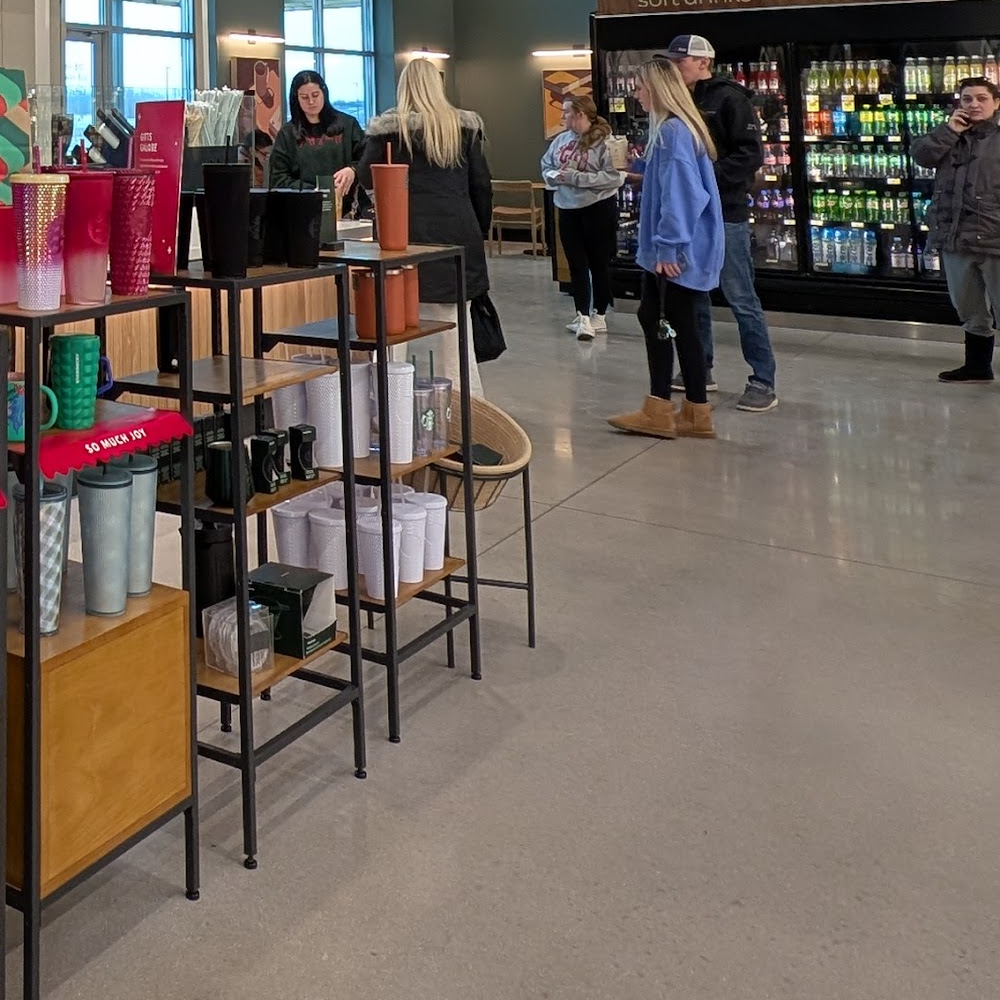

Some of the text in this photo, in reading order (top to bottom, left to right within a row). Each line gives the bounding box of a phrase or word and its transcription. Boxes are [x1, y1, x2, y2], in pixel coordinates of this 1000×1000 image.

[84, 427, 147, 454] SO MUCH JOY
